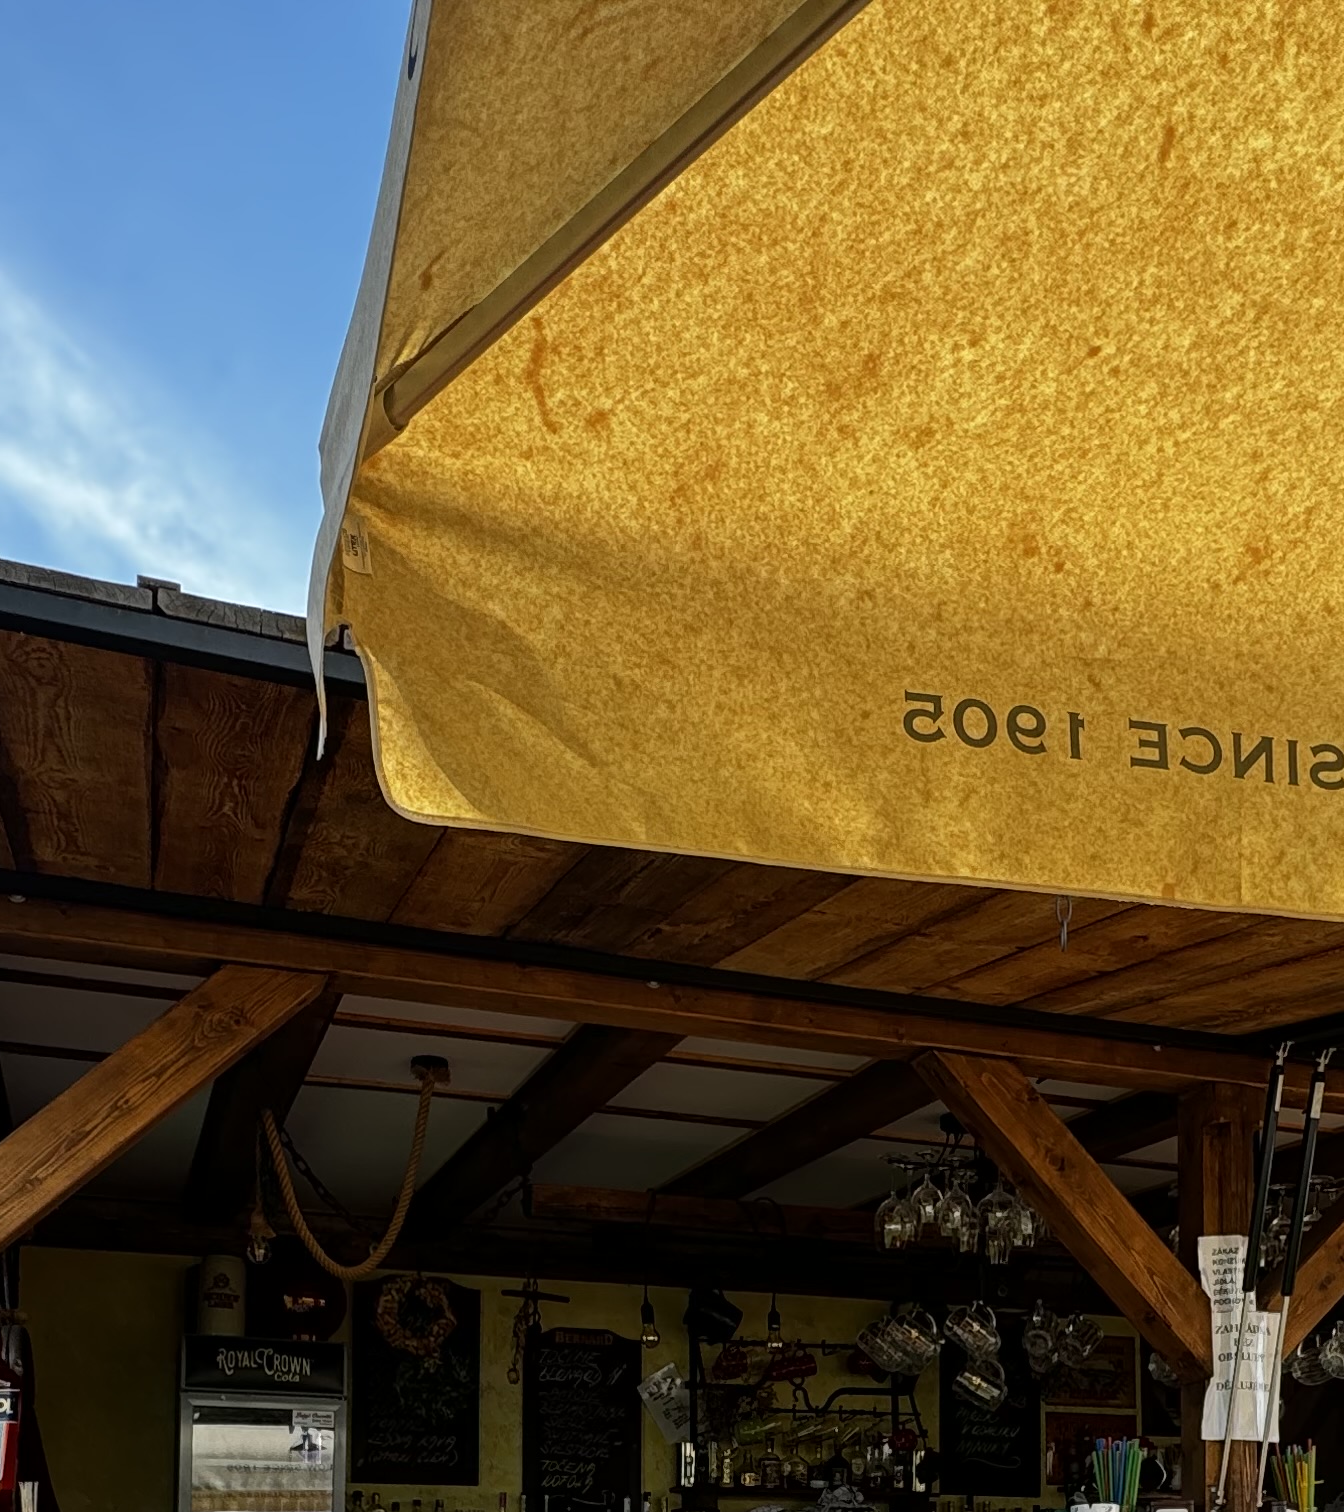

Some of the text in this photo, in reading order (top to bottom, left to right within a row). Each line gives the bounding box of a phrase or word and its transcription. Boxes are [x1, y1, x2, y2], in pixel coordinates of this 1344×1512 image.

[215, 1348, 311, 1377] ROYAL CROWN
[274, 1371, 301, 1382] Cola
